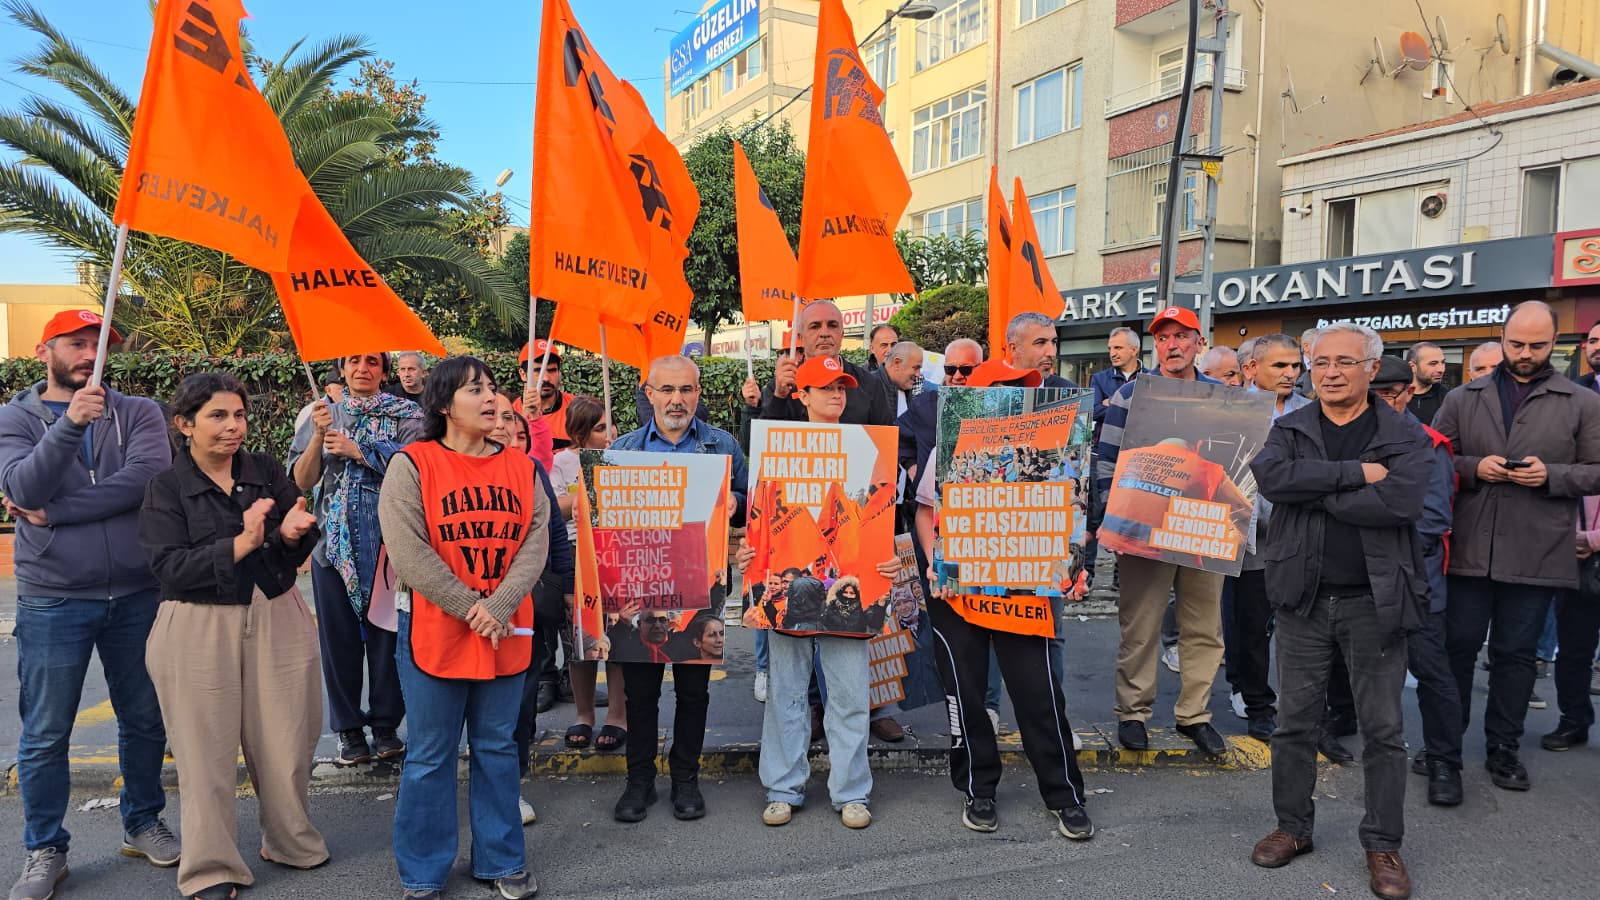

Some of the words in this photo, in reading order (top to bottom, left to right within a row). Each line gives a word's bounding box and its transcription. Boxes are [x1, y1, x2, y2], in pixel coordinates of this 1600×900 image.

[705, 20, 743, 64] MERKEZİ
[555, 251, 648, 291] HALKEVLERİ
[1417, 304, 1511, 330] ÇEŞİTLERİ
[770, 431, 839, 454] HALKIN
[600, 469, 682, 487] GÜVENCELİ
[763, 456, 844, 479] HAKLARI
[601, 489, 680, 508] ÇALIŞMAK
[785, 482, 822, 504] VAR
[949, 484, 1065, 508] GERİCİLİĞİN
[601, 509, 680, 528] İSTİYORUZ
[946, 516, 971, 533] ve
[975, 510, 1066, 536] FAŞİZMİN
[949, 535, 1065, 560] KARŞISINDA
[621, 564, 673, 584] KADRO
[961, 562, 992, 583] BİZ
[996, 562, 1051, 583] VARIZ
[870, 680, 901, 705] VAR
